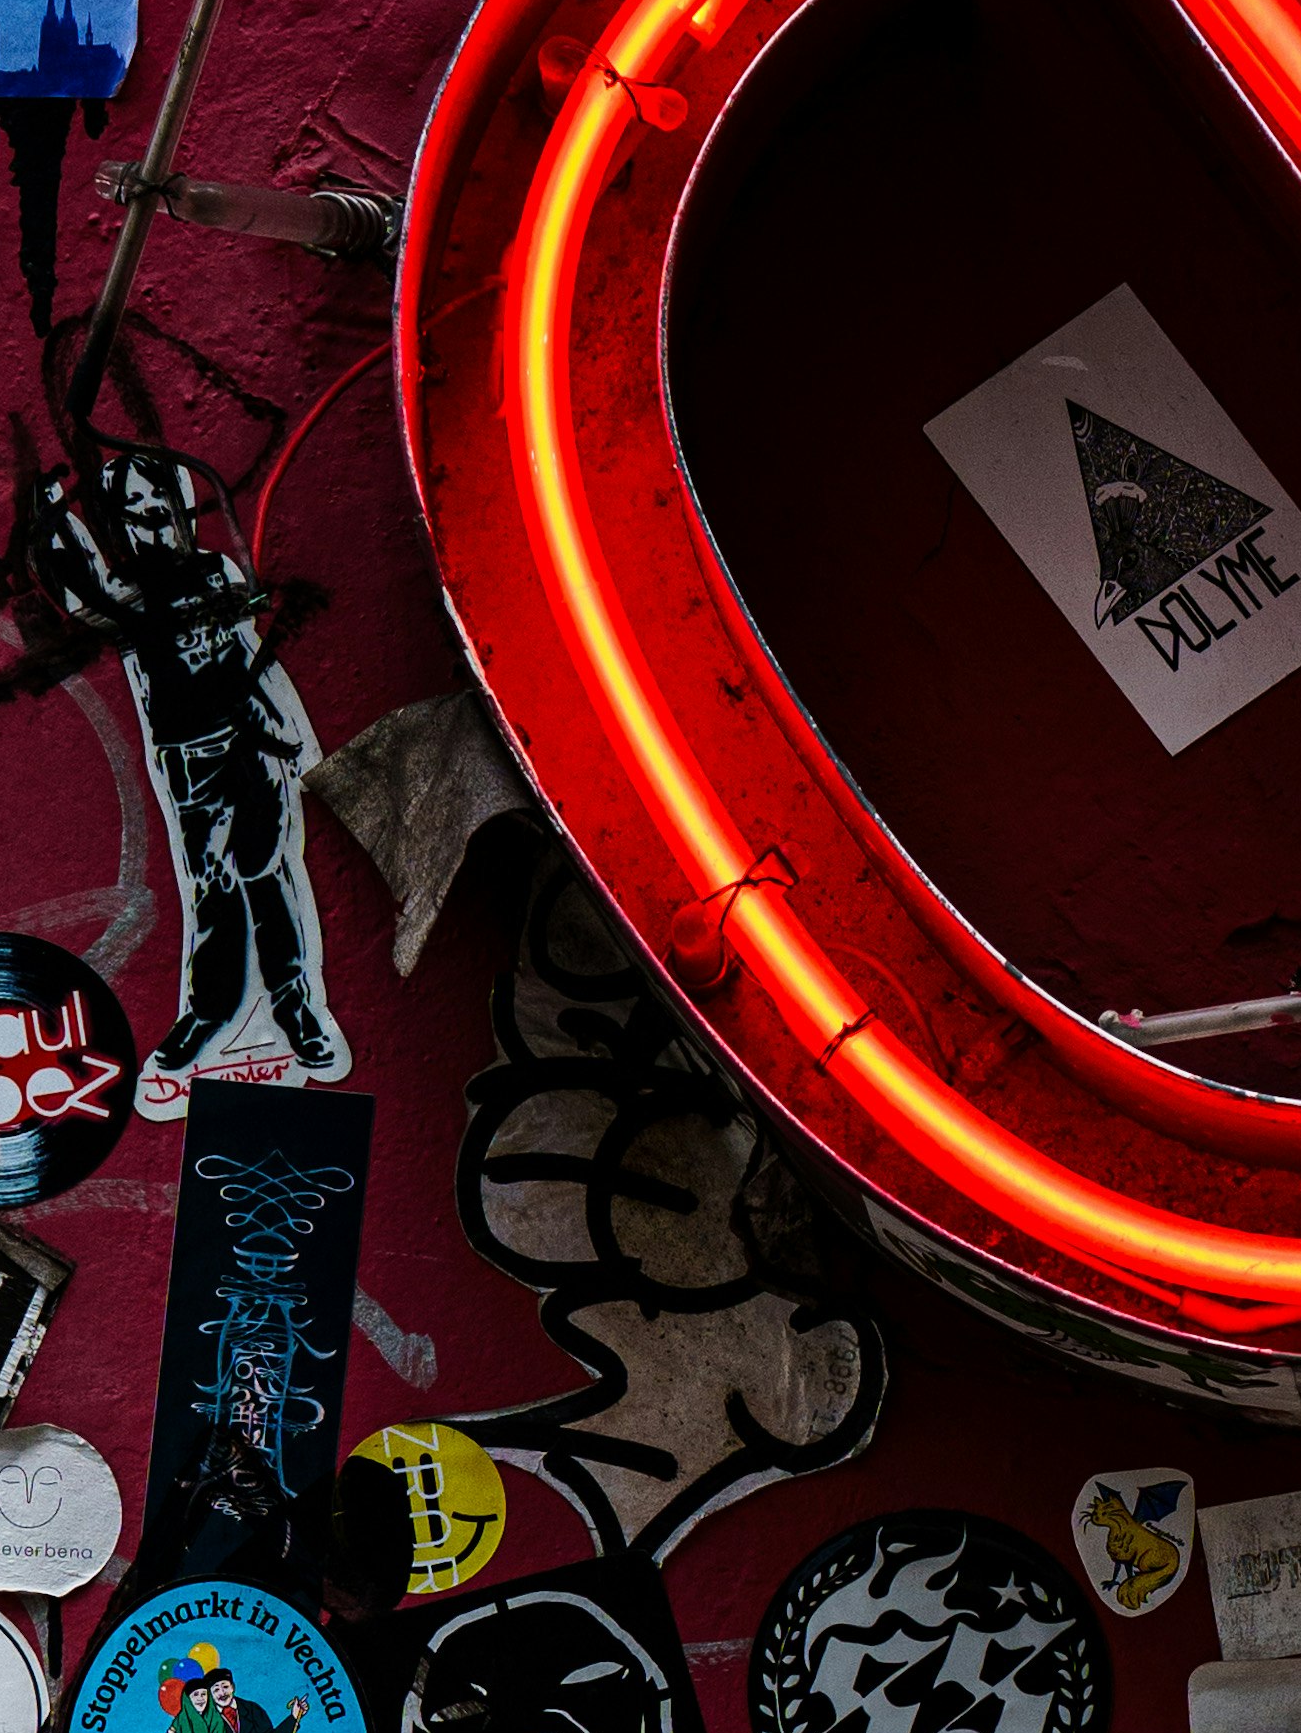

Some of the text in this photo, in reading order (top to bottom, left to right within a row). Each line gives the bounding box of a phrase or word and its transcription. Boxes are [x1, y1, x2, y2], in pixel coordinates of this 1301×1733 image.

[81, 1592, 348, 1733] Stoppelmarkt in Vechta
